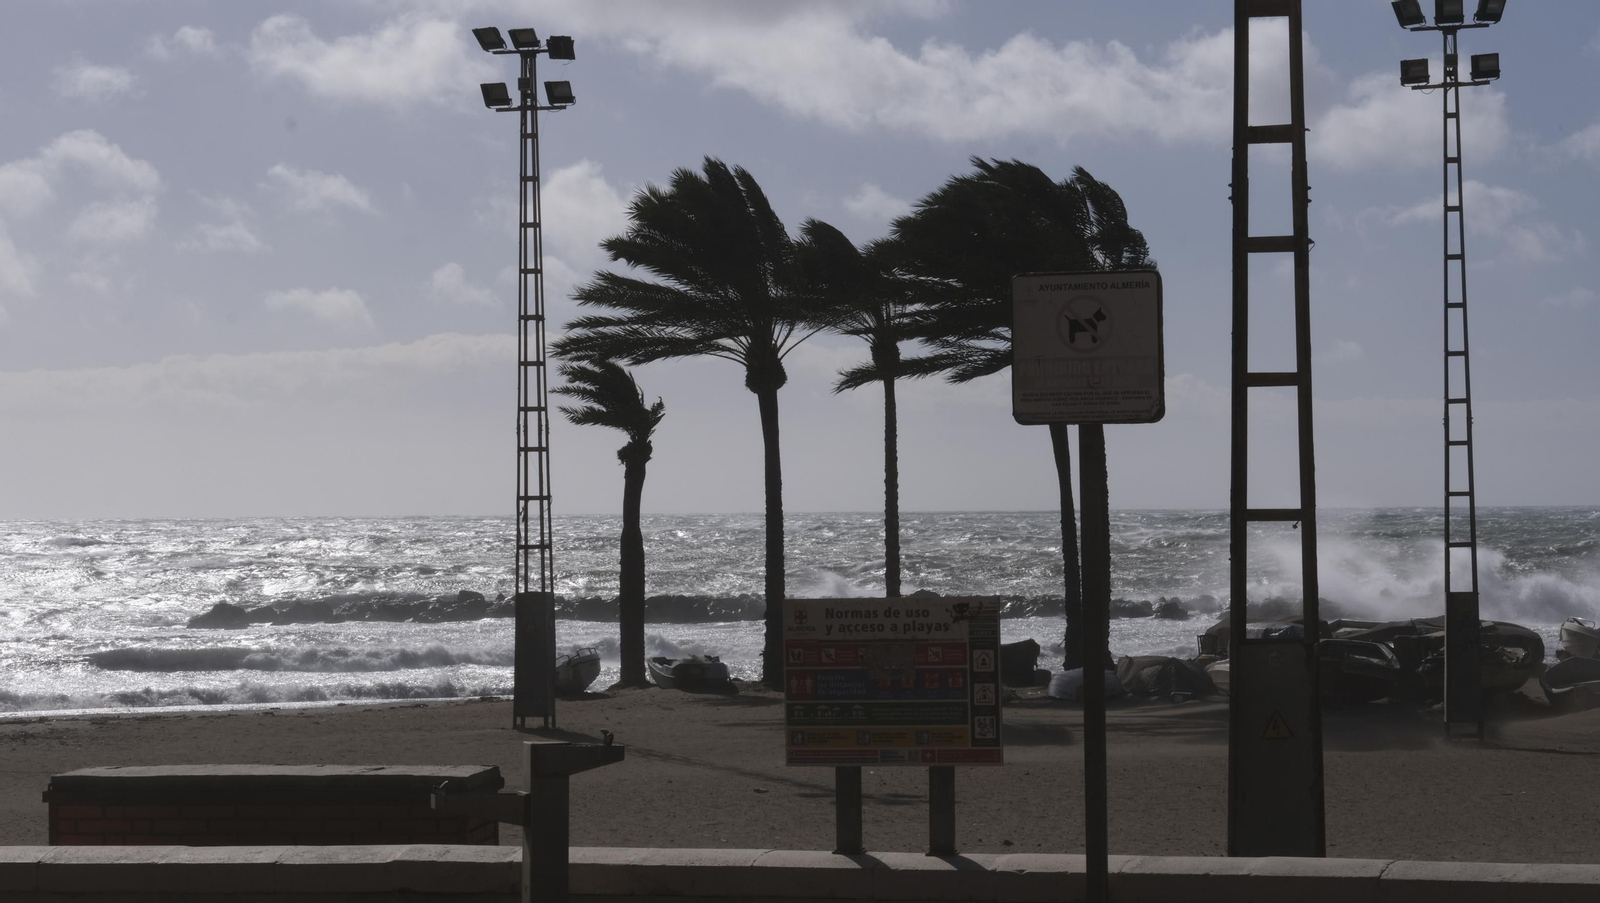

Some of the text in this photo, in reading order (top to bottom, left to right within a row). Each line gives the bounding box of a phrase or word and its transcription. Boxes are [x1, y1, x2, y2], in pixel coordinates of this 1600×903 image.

[1038, 280, 1150, 292] AYUNTAMIENTO ALMERÍA
[825, 606, 930, 619] Normas de uso
[825, 620, 950, 635] y acceso a playas
